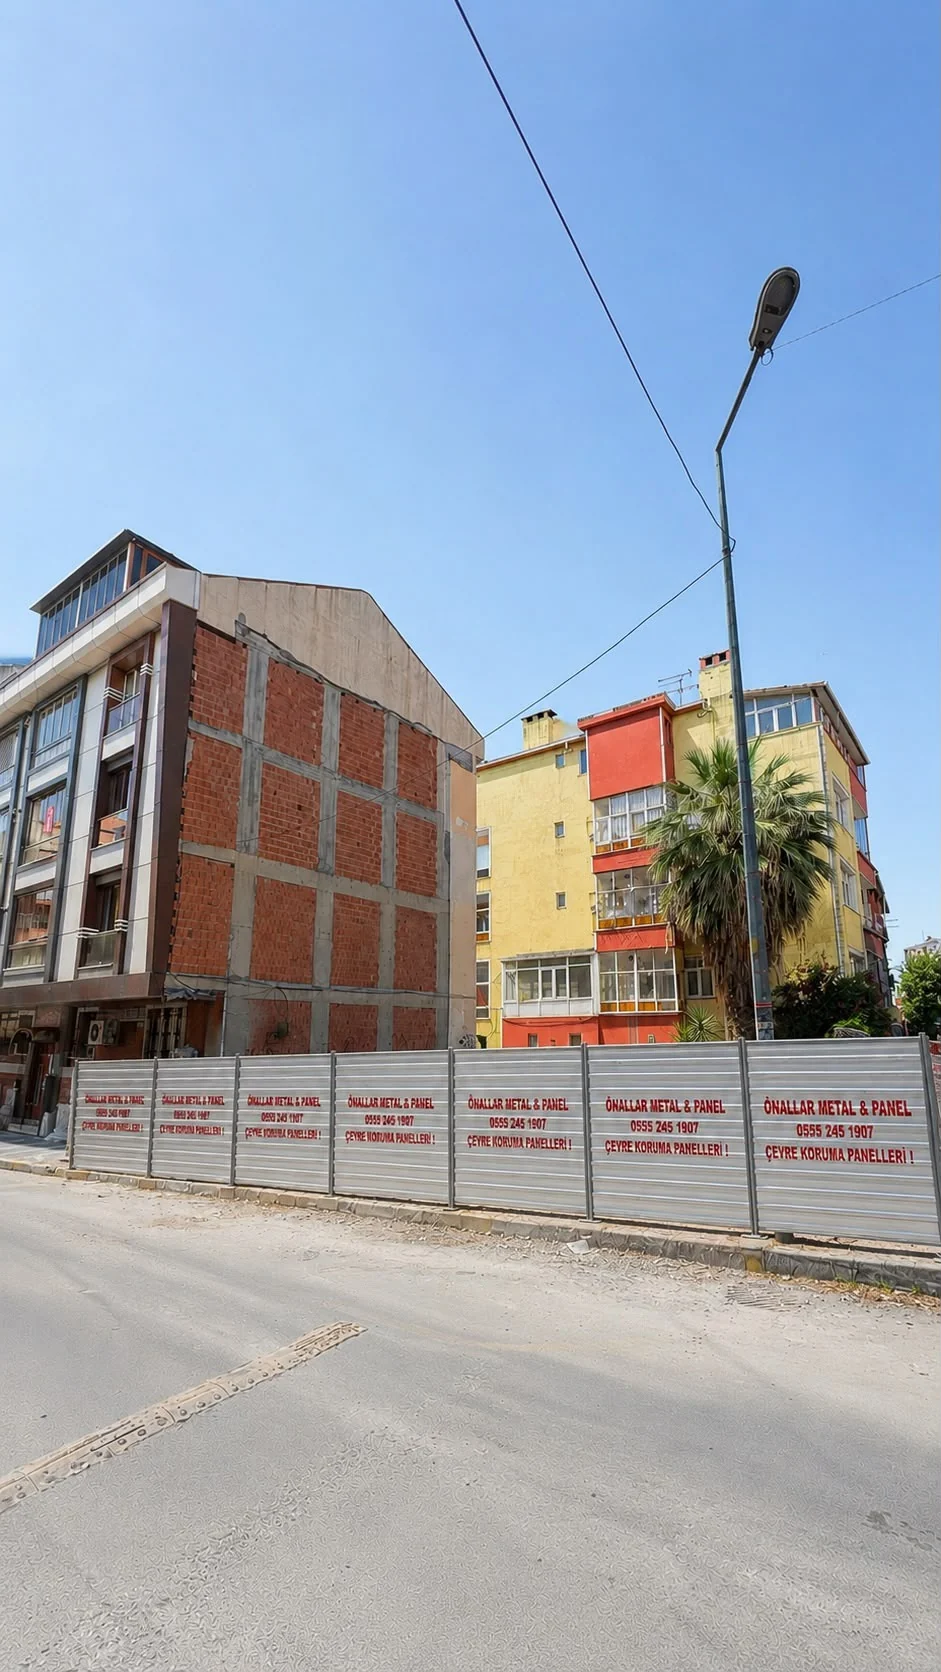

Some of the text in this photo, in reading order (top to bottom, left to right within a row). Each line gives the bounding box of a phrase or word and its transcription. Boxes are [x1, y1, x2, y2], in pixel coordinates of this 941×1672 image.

[411, 1098, 434, 1110] PANEL
[506, 1098, 531, 1110] METAL
[533, 1098, 540, 1110] &
[542, 1098, 568, 1111] PANEL
[650, 1099, 682, 1113] METAL
[684, 1100, 691, 1113] &
[694, 1100, 725, 1114] PANEL
[819, 1100, 856, 1116] METAL
[860, 1100, 868, 1116] &
[872, 1100, 912, 1117] PANEL
[490, 1117, 546, 1130] 0555 245 1907
[630, 1120, 698, 1134] 0555 245 1907
[796, 1124, 874, 1138] 0555 245 1907
[635, 1140, 672, 1154] KORUMA
[674, 1141, 722, 1156] PANELLERİ
[801, 1146, 845, 1162] KORUMA
[848, 1146, 907, 1164] PANELLERİ
